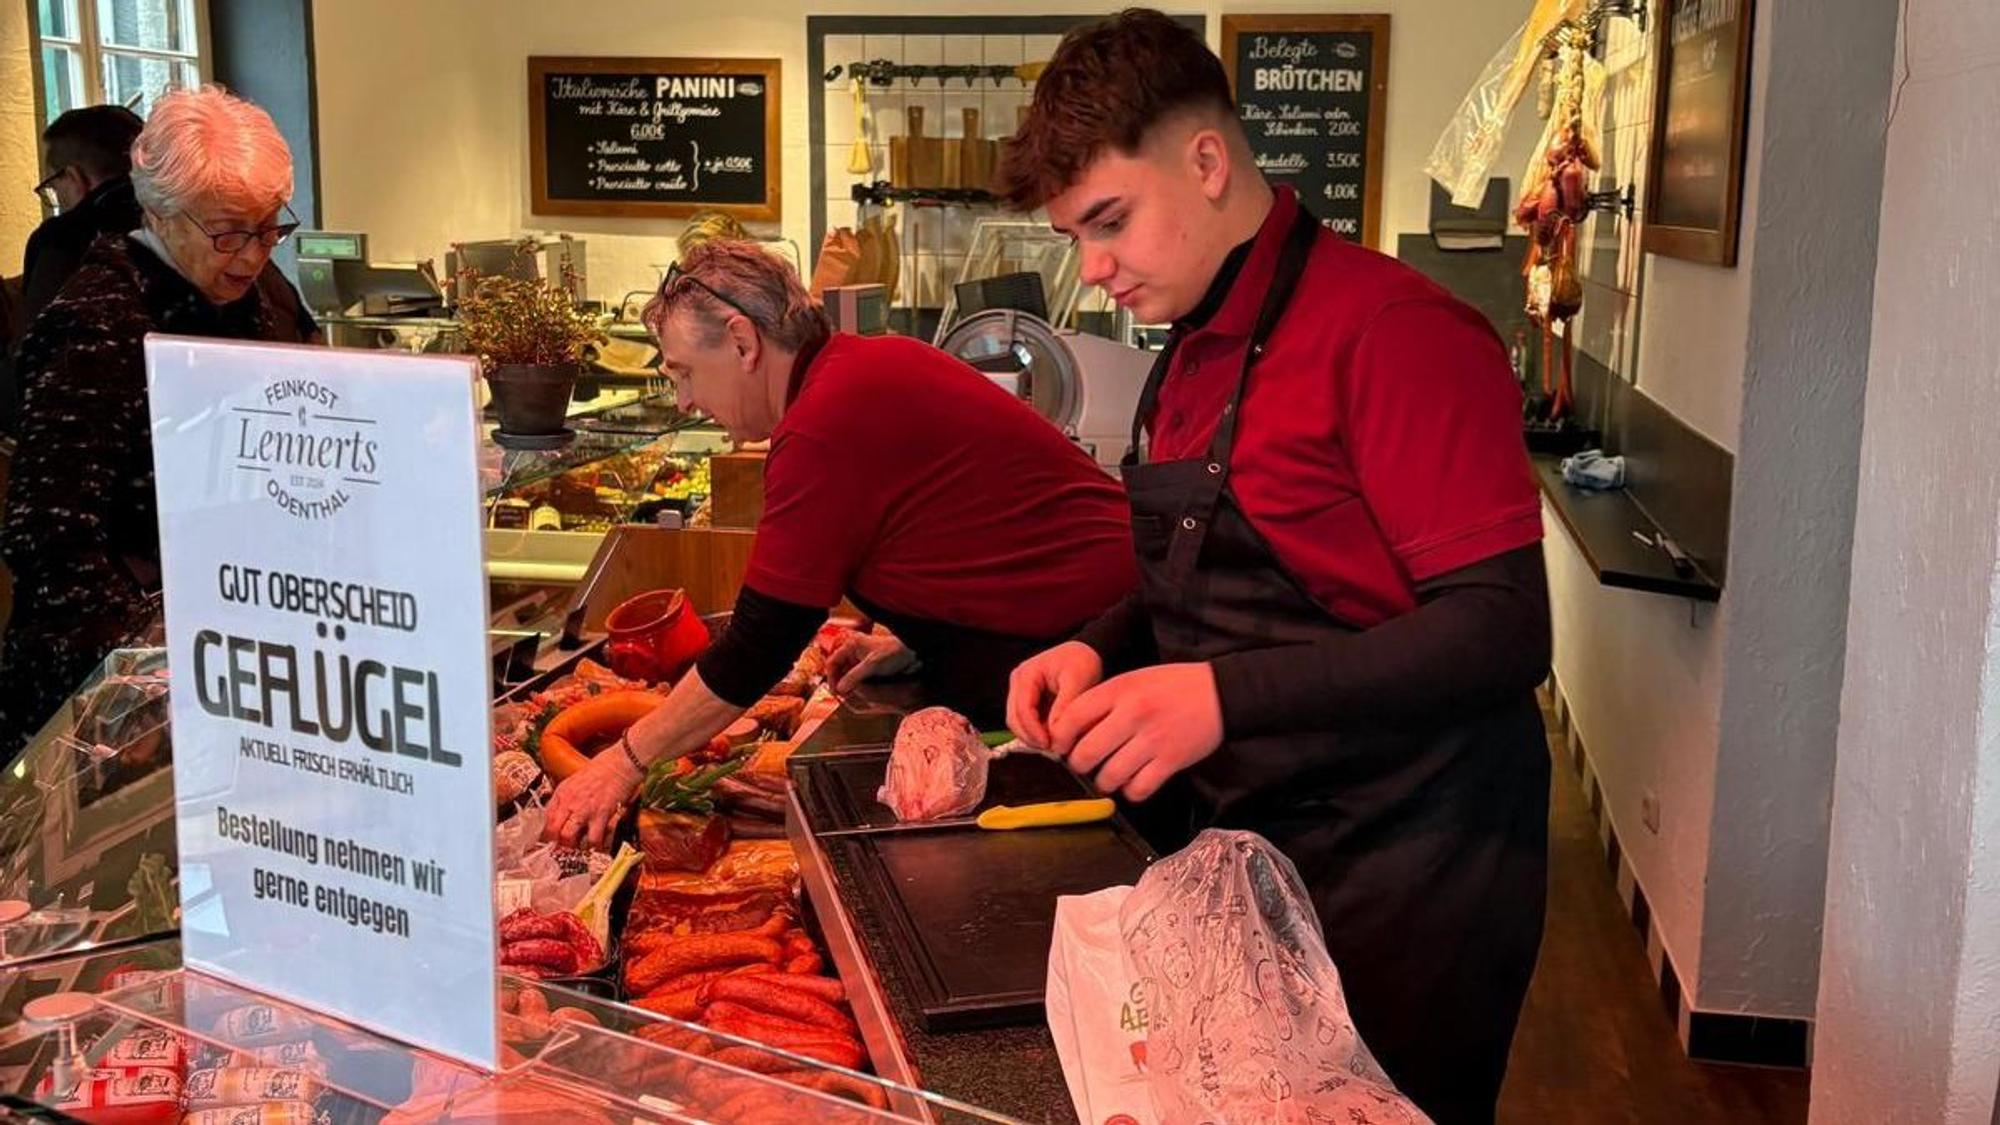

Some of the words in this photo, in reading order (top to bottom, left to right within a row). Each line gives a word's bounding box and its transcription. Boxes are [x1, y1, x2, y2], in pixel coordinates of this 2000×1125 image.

[1250, 37, 1318, 64] Belegte
[656, 76, 735, 98] PANINI
[1255, 64, 1363, 92] BRÖTCHEN
[579, 101, 603, 115] mit
[606, 101, 637, 116] Käse
[639, 101, 649, 116] &
[1278, 104, 1322, 119] Salami
[1264, 121, 1319, 136] Schinken
[596, 140, 639, 154] Salami
[597, 159, 651, 172] Prosciutto
[596, 176, 651, 190] Prosciutto
[264, 380, 338, 410] FEINKOST
[237, 417, 379, 473] Lennerts
[267, 479, 350, 520] ODENTHAL
[219, 563, 262, 605] GUT
[268, 572, 418, 631] OBERSCHEID
[193, 621, 462, 768] GEFLÜGEL
[240, 736, 291, 766] AKTUELL
[293, 749, 335, 777] FRISCH
[339, 757, 414, 795] ERHÄLTLICH
[217, 806, 318, 865] Bestellung
[324, 837, 406, 885] nehmen
[412, 859, 446, 897] wir
[254, 867, 309, 907] gerne
[315, 885, 410, 937] entgegen
